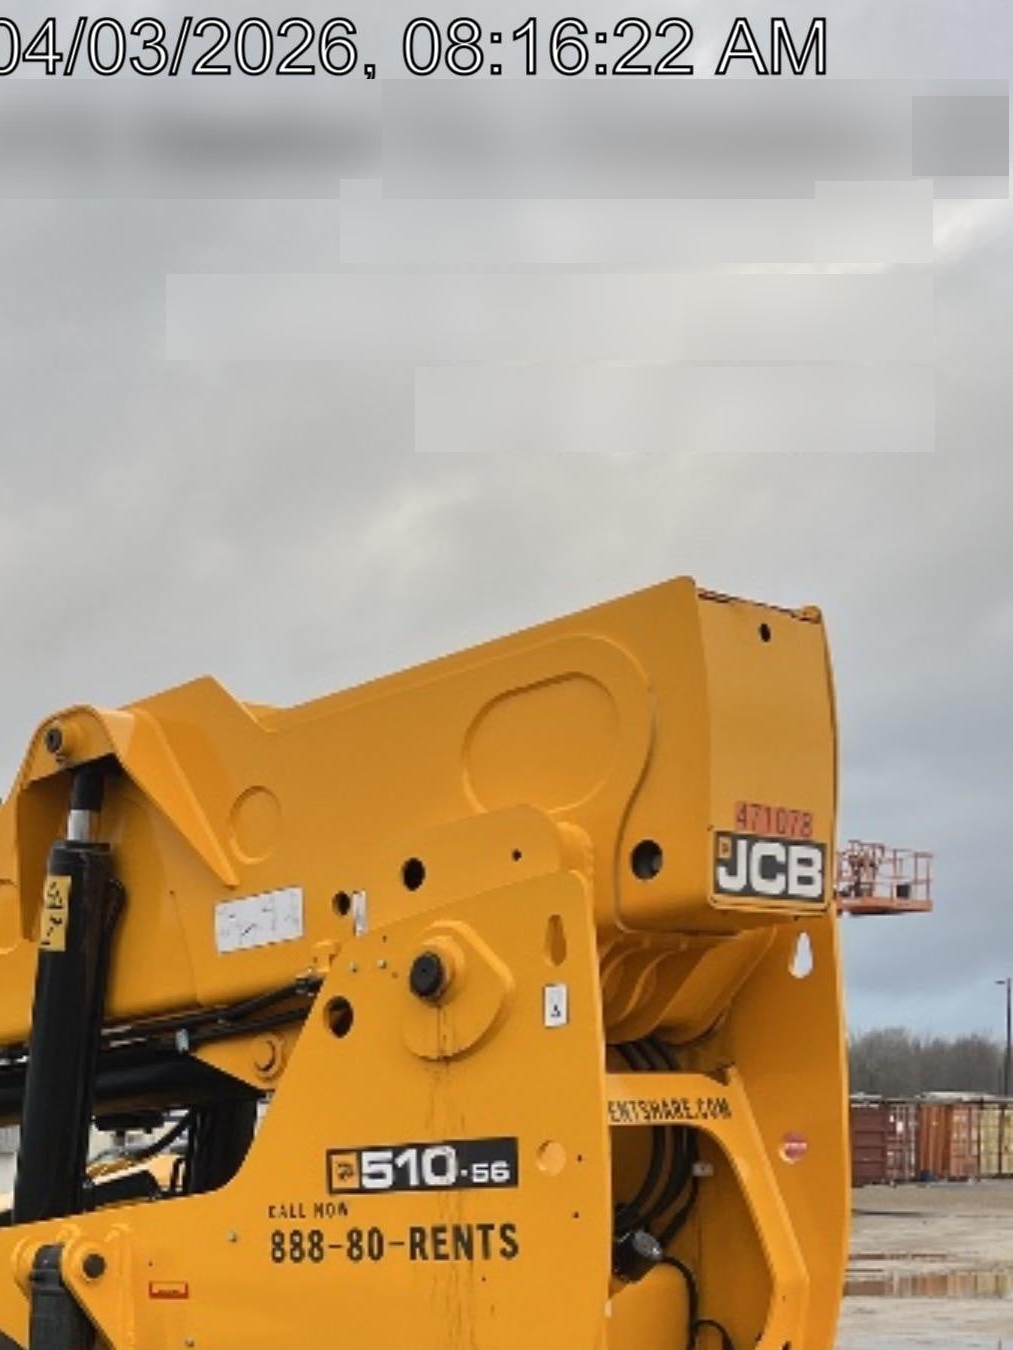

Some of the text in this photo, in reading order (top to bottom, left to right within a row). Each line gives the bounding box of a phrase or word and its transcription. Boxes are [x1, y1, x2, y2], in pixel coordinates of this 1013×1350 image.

[736, 802, 813, 838] 471078
[716, 839, 823, 898] JCB
[608, 1097, 732, 1124] ENTSHARE.COM
[268, 1200, 349, 1220] CALL NOW
[271, 1222, 520, 1264] 888-80-RENTS
